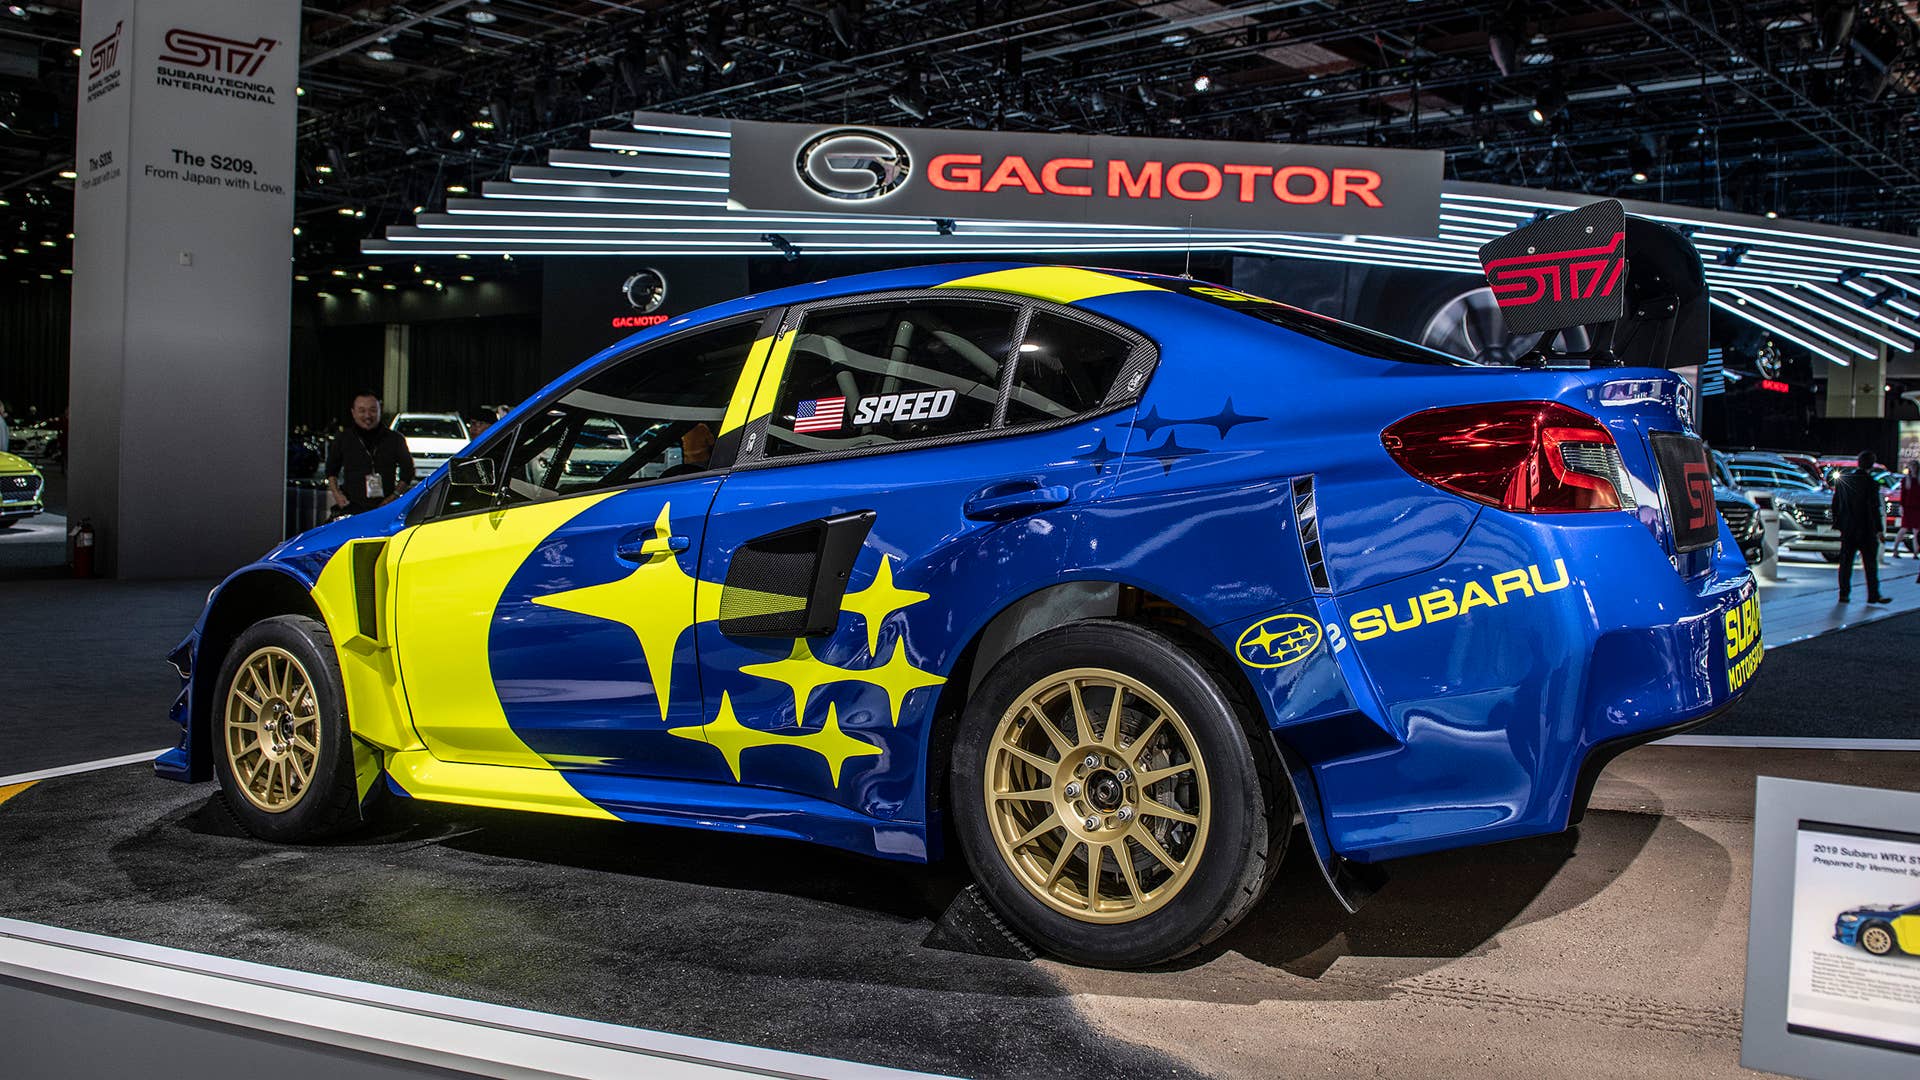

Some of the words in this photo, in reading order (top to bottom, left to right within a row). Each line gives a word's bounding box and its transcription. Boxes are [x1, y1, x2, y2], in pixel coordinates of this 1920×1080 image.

[156, 76, 275, 105] INTERNATIONAL
[157, 66, 215, 84] SUBARU
[217, 76, 275, 95] TECNICA
[172, 148, 206, 168] The
[210, 154, 258, 175] S209.
[144, 165, 179, 180] From
[182, 170, 221, 186] Japan
[224, 176, 250, 190] with
[253, 180, 286, 196] Love.
[926, 154, 1093, 197] GAC
[1107, 161, 1384, 208] MOTOR
[853, 389, 957, 425] SPEED
[1349, 557, 1570, 642] SUBARU
[1813, 844, 1838, 855] 2019
[1840, 847, 1878, 860] Subaru
[1880, 852, 1906, 864] WRX
